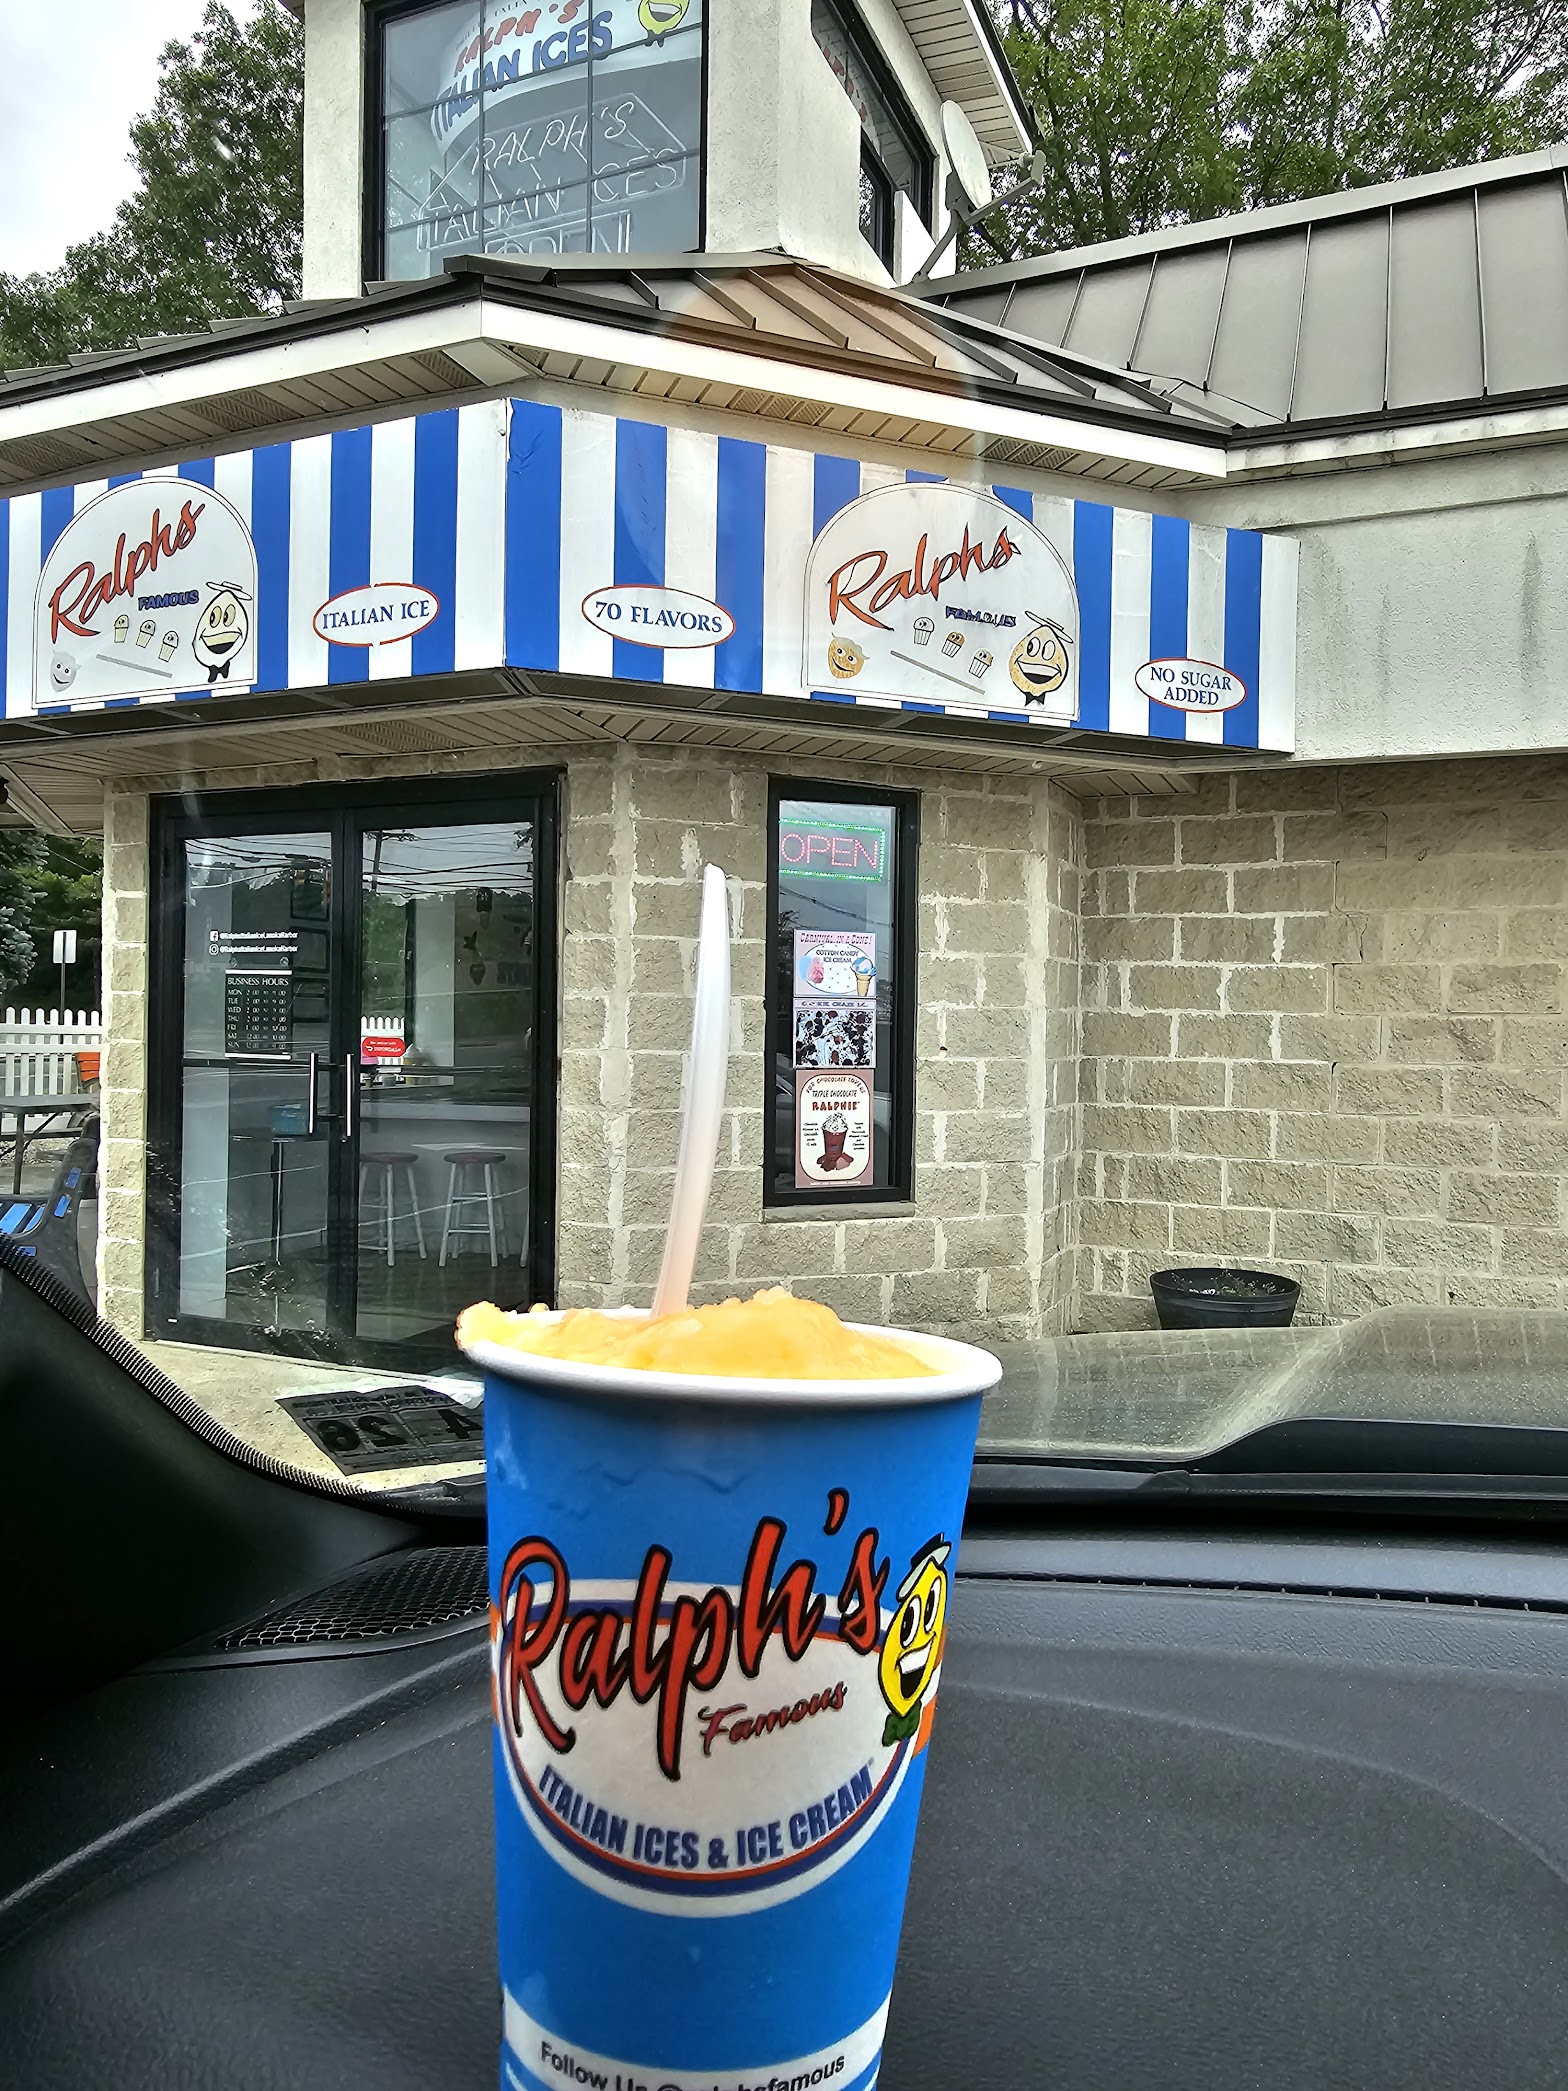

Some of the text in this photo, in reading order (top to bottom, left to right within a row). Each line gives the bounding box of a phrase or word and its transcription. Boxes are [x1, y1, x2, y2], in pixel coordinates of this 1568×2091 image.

[532, 10, 613, 73] ICES
[472, 101, 635, 175] RALPH'S
[587, 147, 678, 202] CES
[48, 499, 206, 645] Ralphs
[824, 521, 1022, 632] Ralphs
[138, 589, 200, 611] FAMOUS
[322, 599, 430, 630] ITALIAN ICE
[595, 601, 723, 633] 70 FLAVORS
[1150, 666, 1232, 691] NO SUGAR
[1163, 686, 1220, 706] ADDED
[781, 833, 879, 869] OPEN
[815, 949, 839, 957] COTTON
[227, 977, 289, 987] BUSINESS HOURS
[812, 1089, 858, 1098] TRIPLE CHOCOLATE
[816, 1076, 847, 1085] CHOCOLATE
[812, 1101, 858, 1111] RALPHIE
[501, 1487, 890, 1782] Ralph's
[697, 1680, 848, 1759] Famous
[539, 1763, 875, 1871] ITALIAN ICES & ICE CREAM
[541, 2041, 608, 2091] Follow
